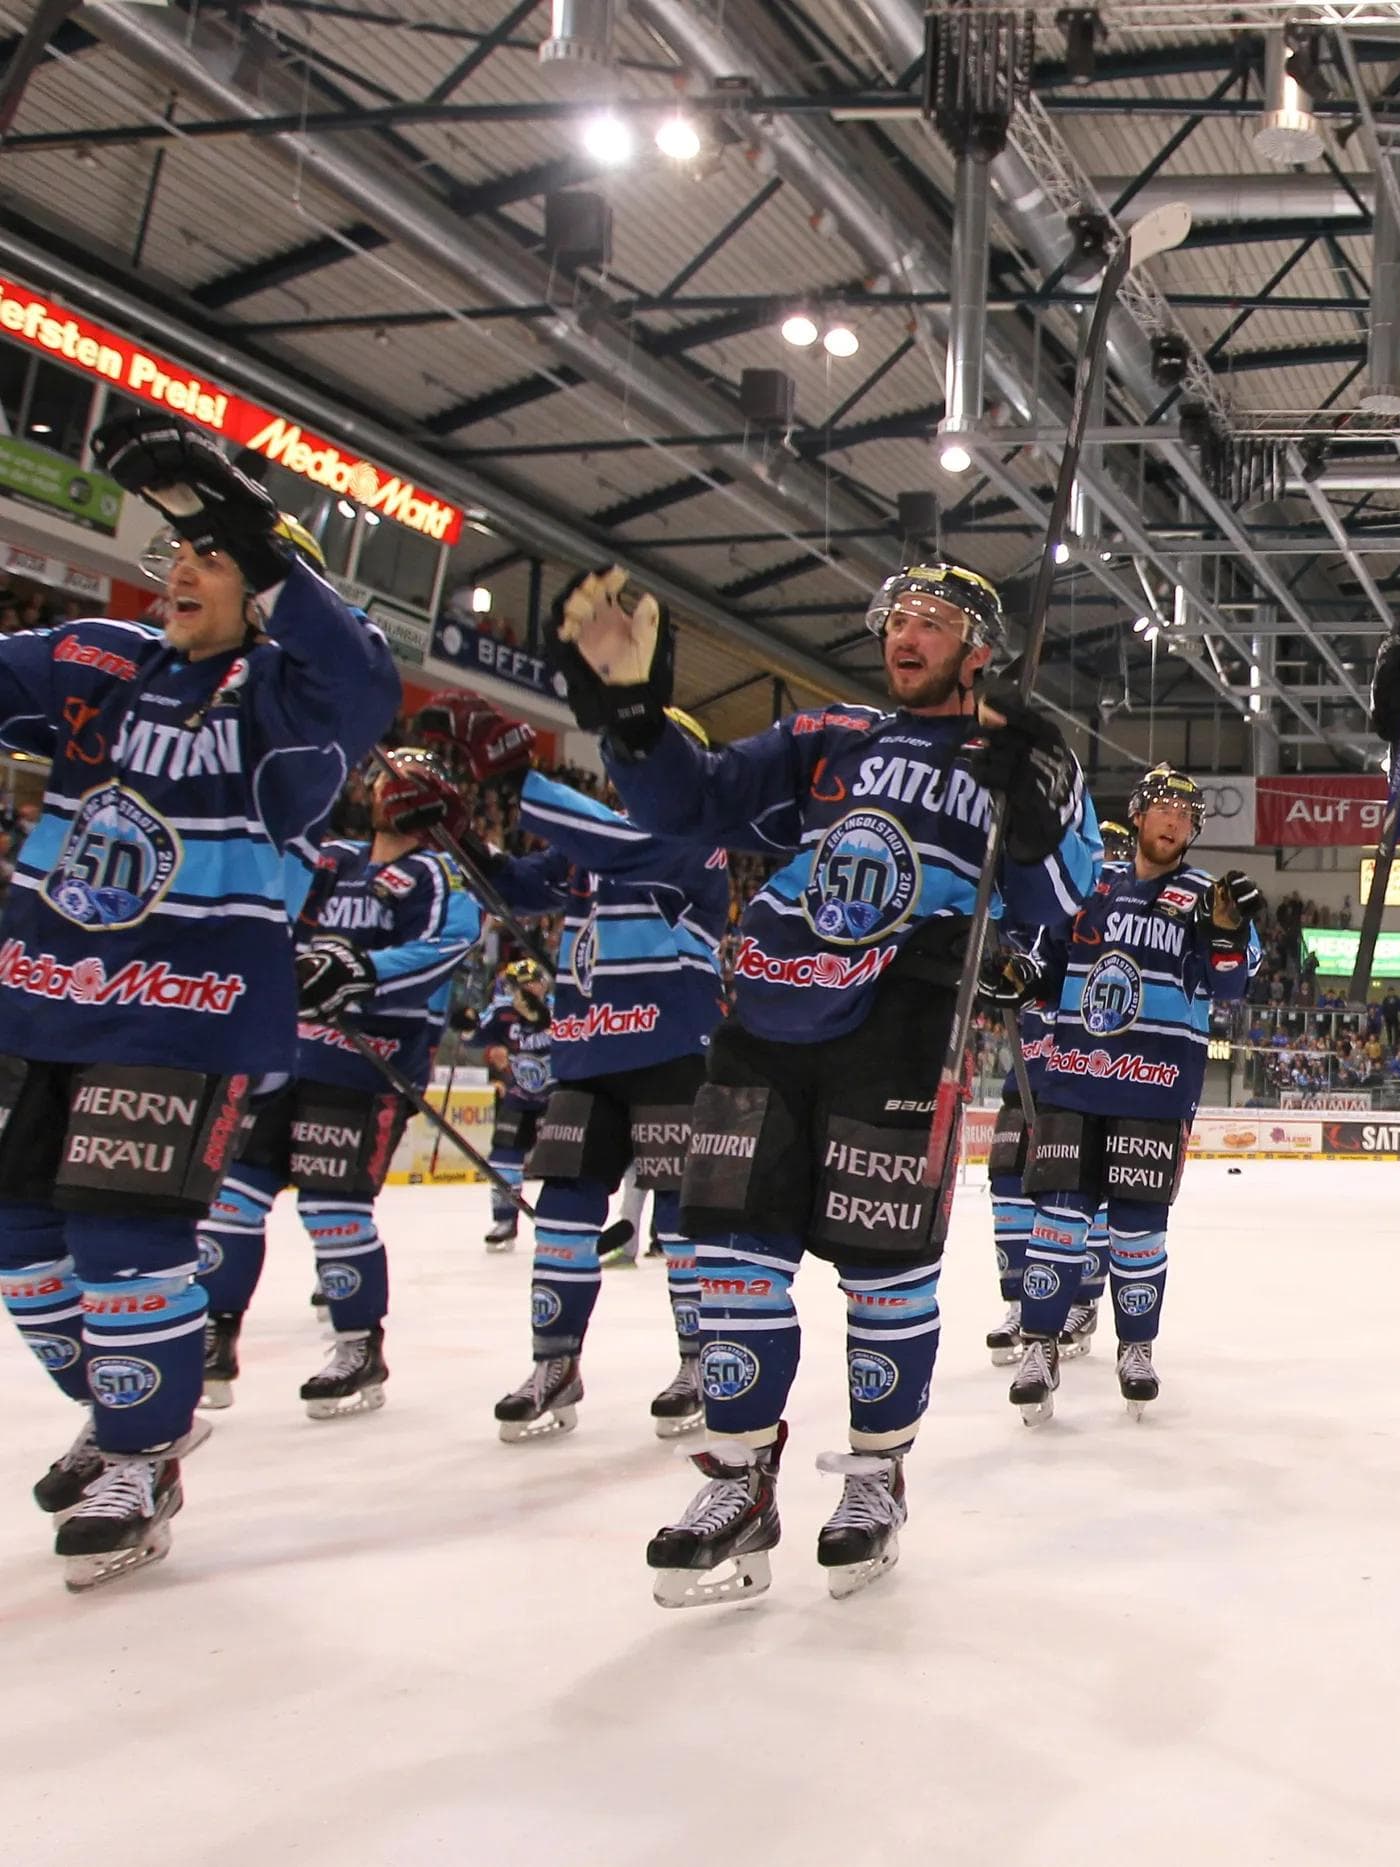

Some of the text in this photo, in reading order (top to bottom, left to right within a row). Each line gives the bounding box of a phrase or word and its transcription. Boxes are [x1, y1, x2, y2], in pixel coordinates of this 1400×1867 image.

[127, 352, 229, 429] Preis!
[246, 417, 456, 540] Media Markt
[1285, 799, 1351, 823] Auf
[844, 816, 907, 857] INGOLSTADT
[826, 855, 889, 906] 50
[93, 958, 246, 1015] Markt
[1093, 983, 1128, 1012] 50
[1103, 1054, 1181, 1088] Markt
[71, 1085, 198, 1127] HERRN
[66, 1134, 176, 1173] BRÄU
[689, 1132, 757, 1159] SATURN
[1035, 1143, 1081, 1161] SATURN
[1105, 1134, 1174, 1161] HERRN
[1108, 1166, 1164, 1190] BRÄU
[825, 1190, 922, 1231] BRÄU
